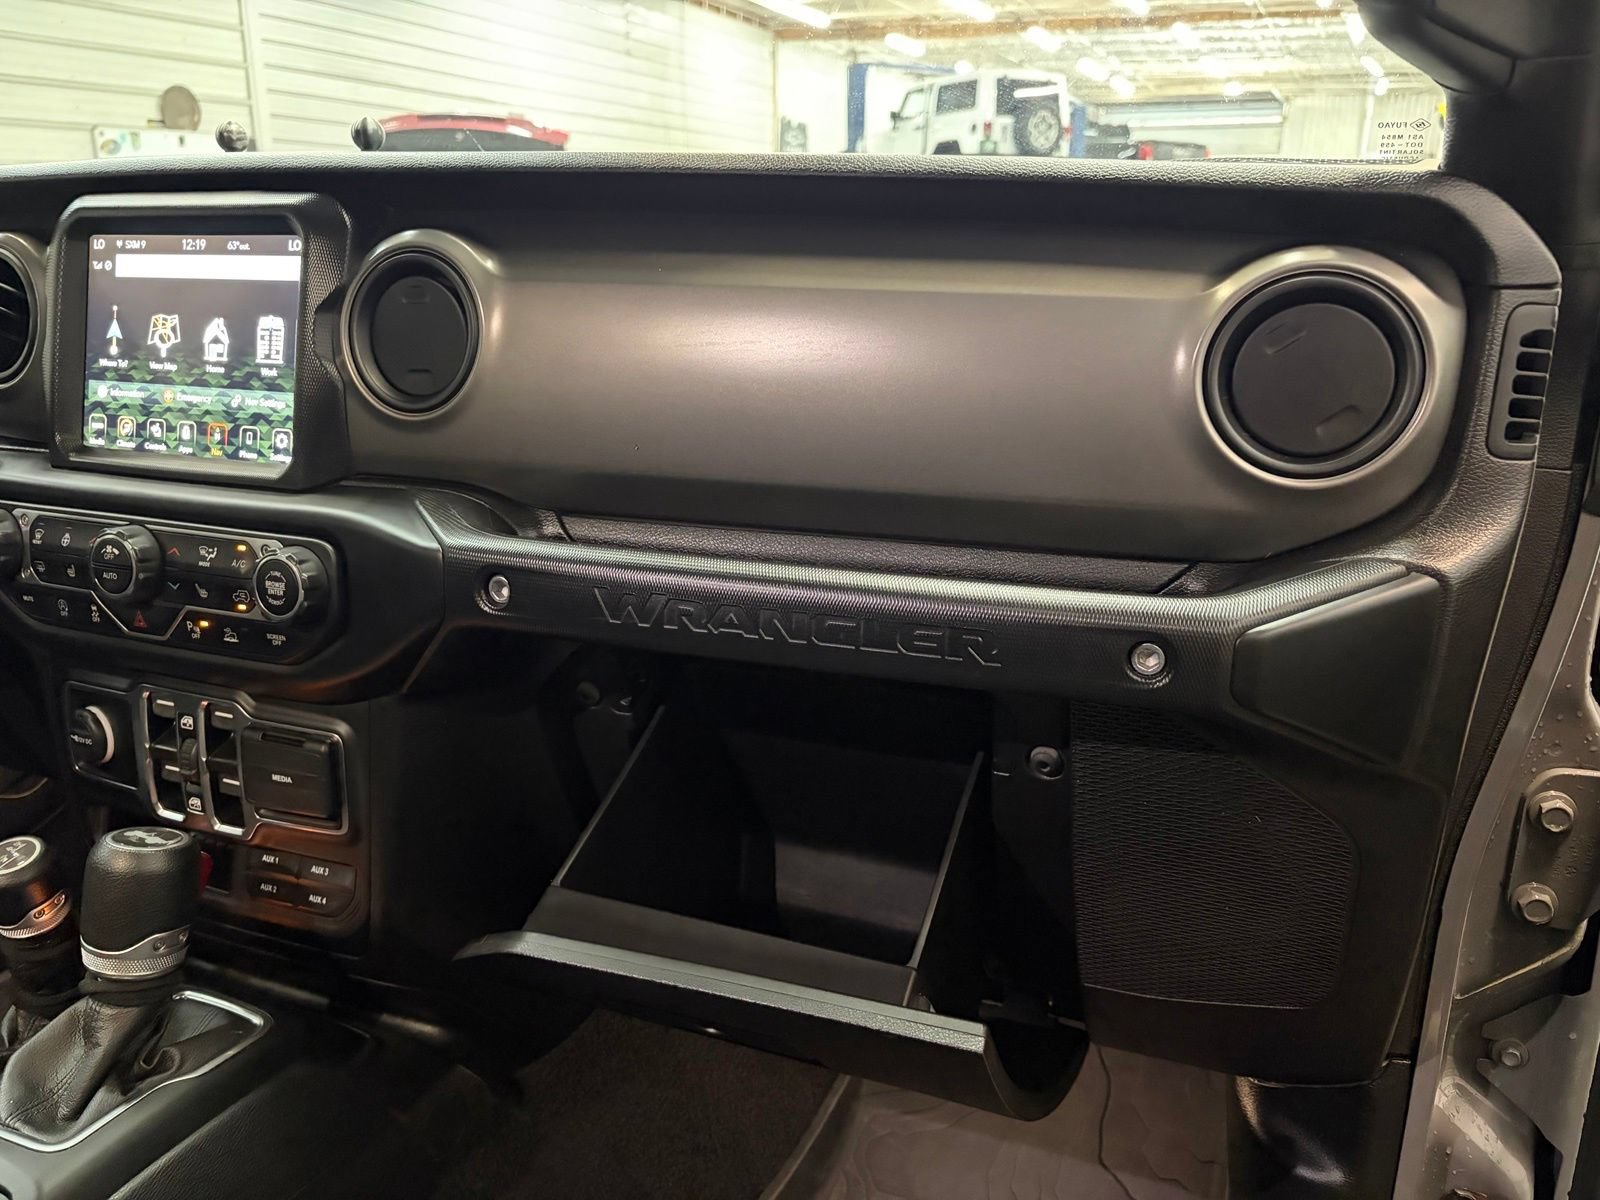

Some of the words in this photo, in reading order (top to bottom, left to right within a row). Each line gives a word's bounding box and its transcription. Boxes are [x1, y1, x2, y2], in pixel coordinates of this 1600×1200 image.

[93, 239, 106, 250] LO
[182, 239, 207, 251] 12:19
[287, 239, 302, 252] LO
[211, 447, 224, 456] Nav
[231, 559, 247, 568] A/C
[102, 572, 118, 580] AUTO
[265, 580, 286, 589] BROWSE
[267, 588, 284, 596] ENTER
[593, 586, 1002, 668] WRANGLER
[266, 633, 286, 641] SCREEN
[271, 638, 282, 646] OFF
[271, 773, 293, 784] MEDIA
[261, 854, 276, 864] AUX
[310, 865, 324, 875] AUX
[324, 867, 329, 876] 3
[260, 883, 274, 892] AUX
[273, 885, 278, 893] 2
[308, 894, 322, 904] AUX
[321, 896, 327, 905] 4
